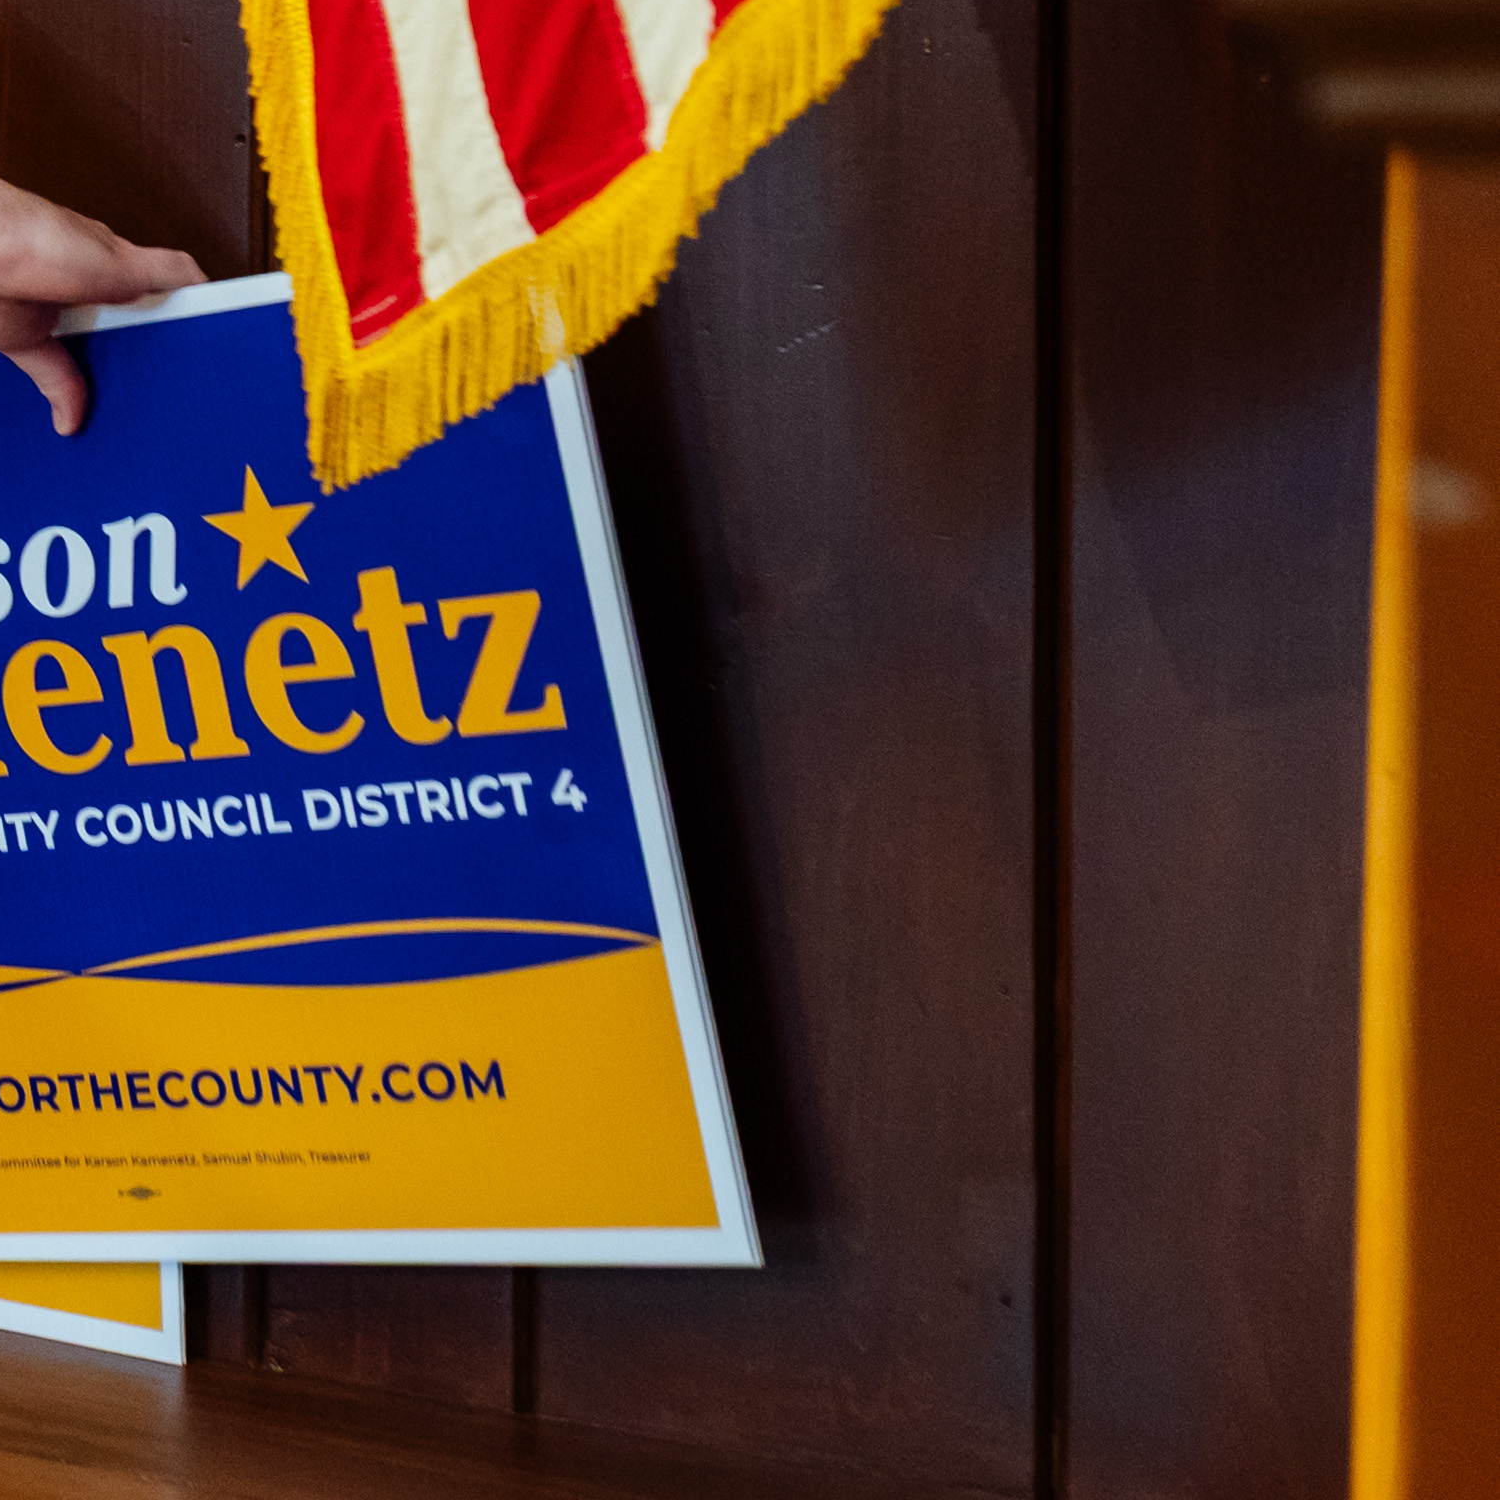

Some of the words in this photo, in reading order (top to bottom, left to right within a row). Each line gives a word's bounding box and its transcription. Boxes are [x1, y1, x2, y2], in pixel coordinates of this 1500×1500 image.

[75, 793, 292, 847] COUNCIL
[302, 772, 532, 831] DISTRICT
[551, 769, 587, 812] 4
